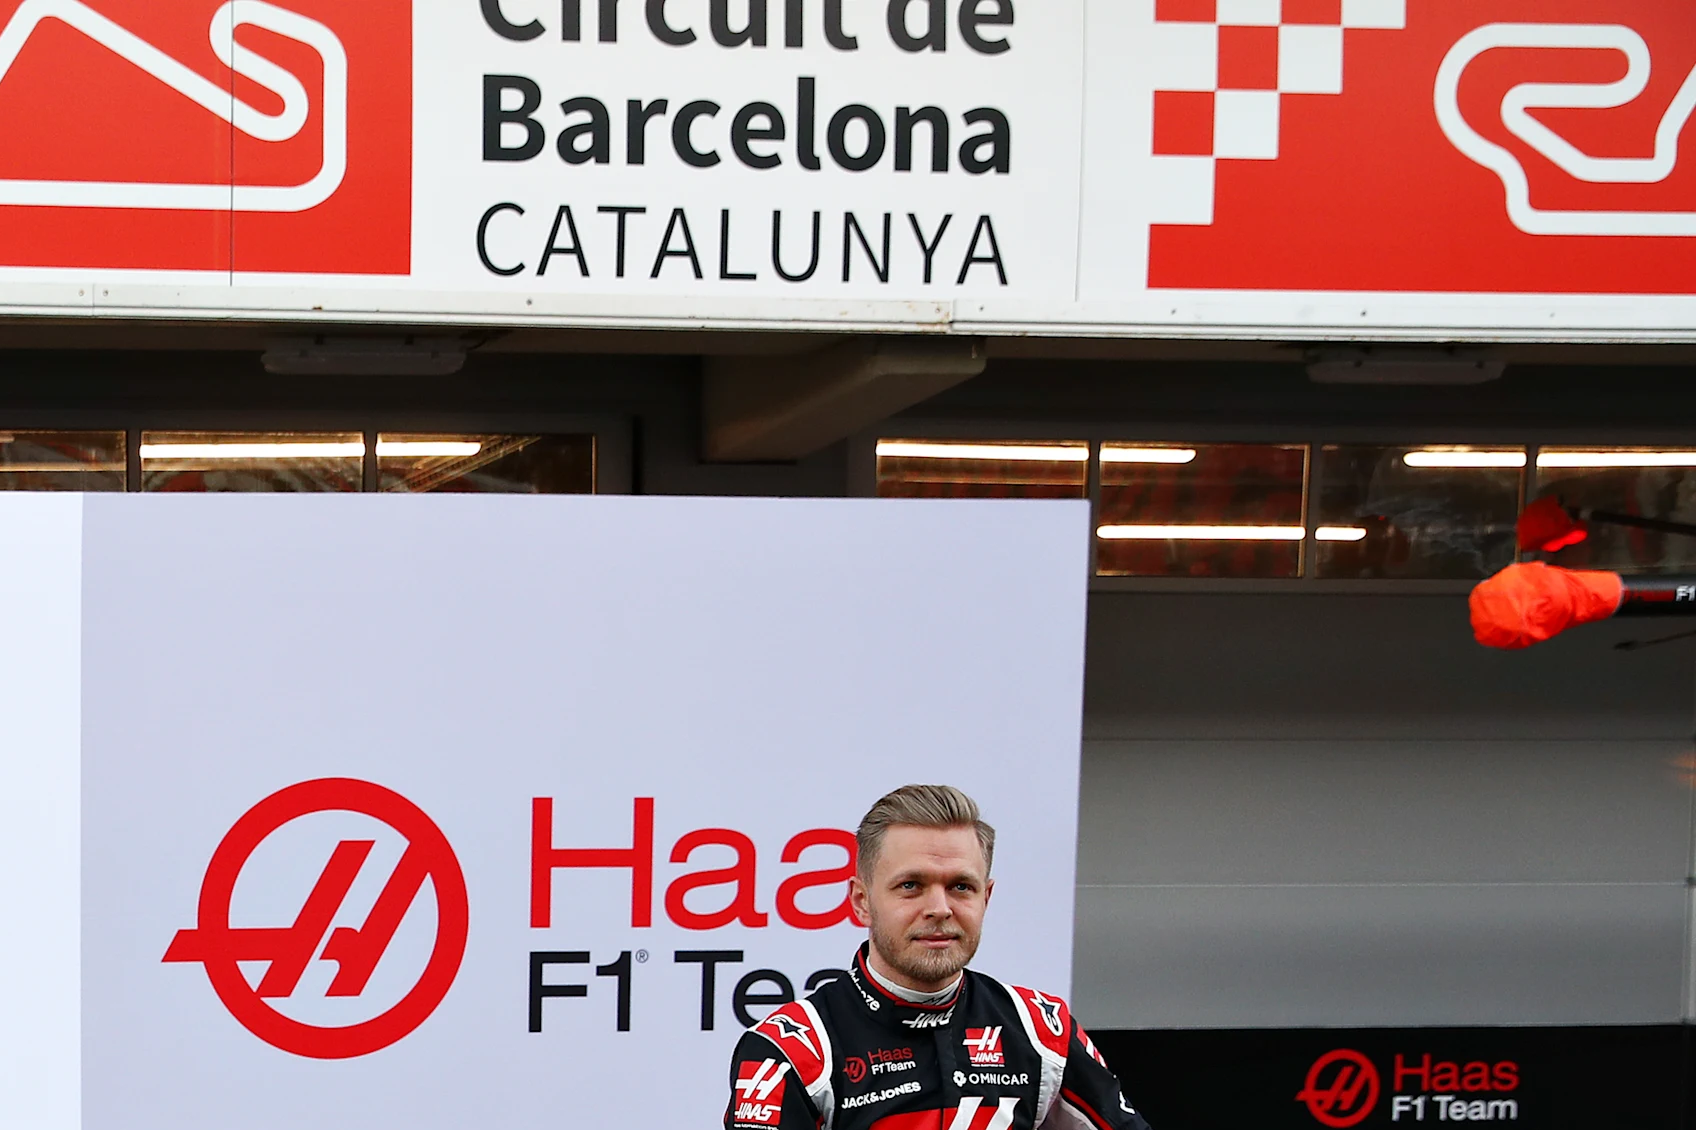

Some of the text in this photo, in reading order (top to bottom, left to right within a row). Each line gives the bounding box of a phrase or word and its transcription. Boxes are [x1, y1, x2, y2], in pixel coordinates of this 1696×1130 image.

[887, 0, 1014, 55] de
[481, 74, 1011, 175] Barcelona
[476, 202, 1009, 286] CATALUNYA
[530, 797, 866, 930] Haa
[674, 950, 850, 1031] Te
[867, 1047, 913, 1063] Haas
[871, 1060, 916, 1076] F1 Team
[968, 1073, 1029, 1086] OMNICAR
[1395, 1054, 1519, 1092] Haas
[734, 1102, 781, 1121] HAAS
[841, 1081, 921, 1109] JACK&JONES
[1391, 1095, 1518, 1122] F1 Team
